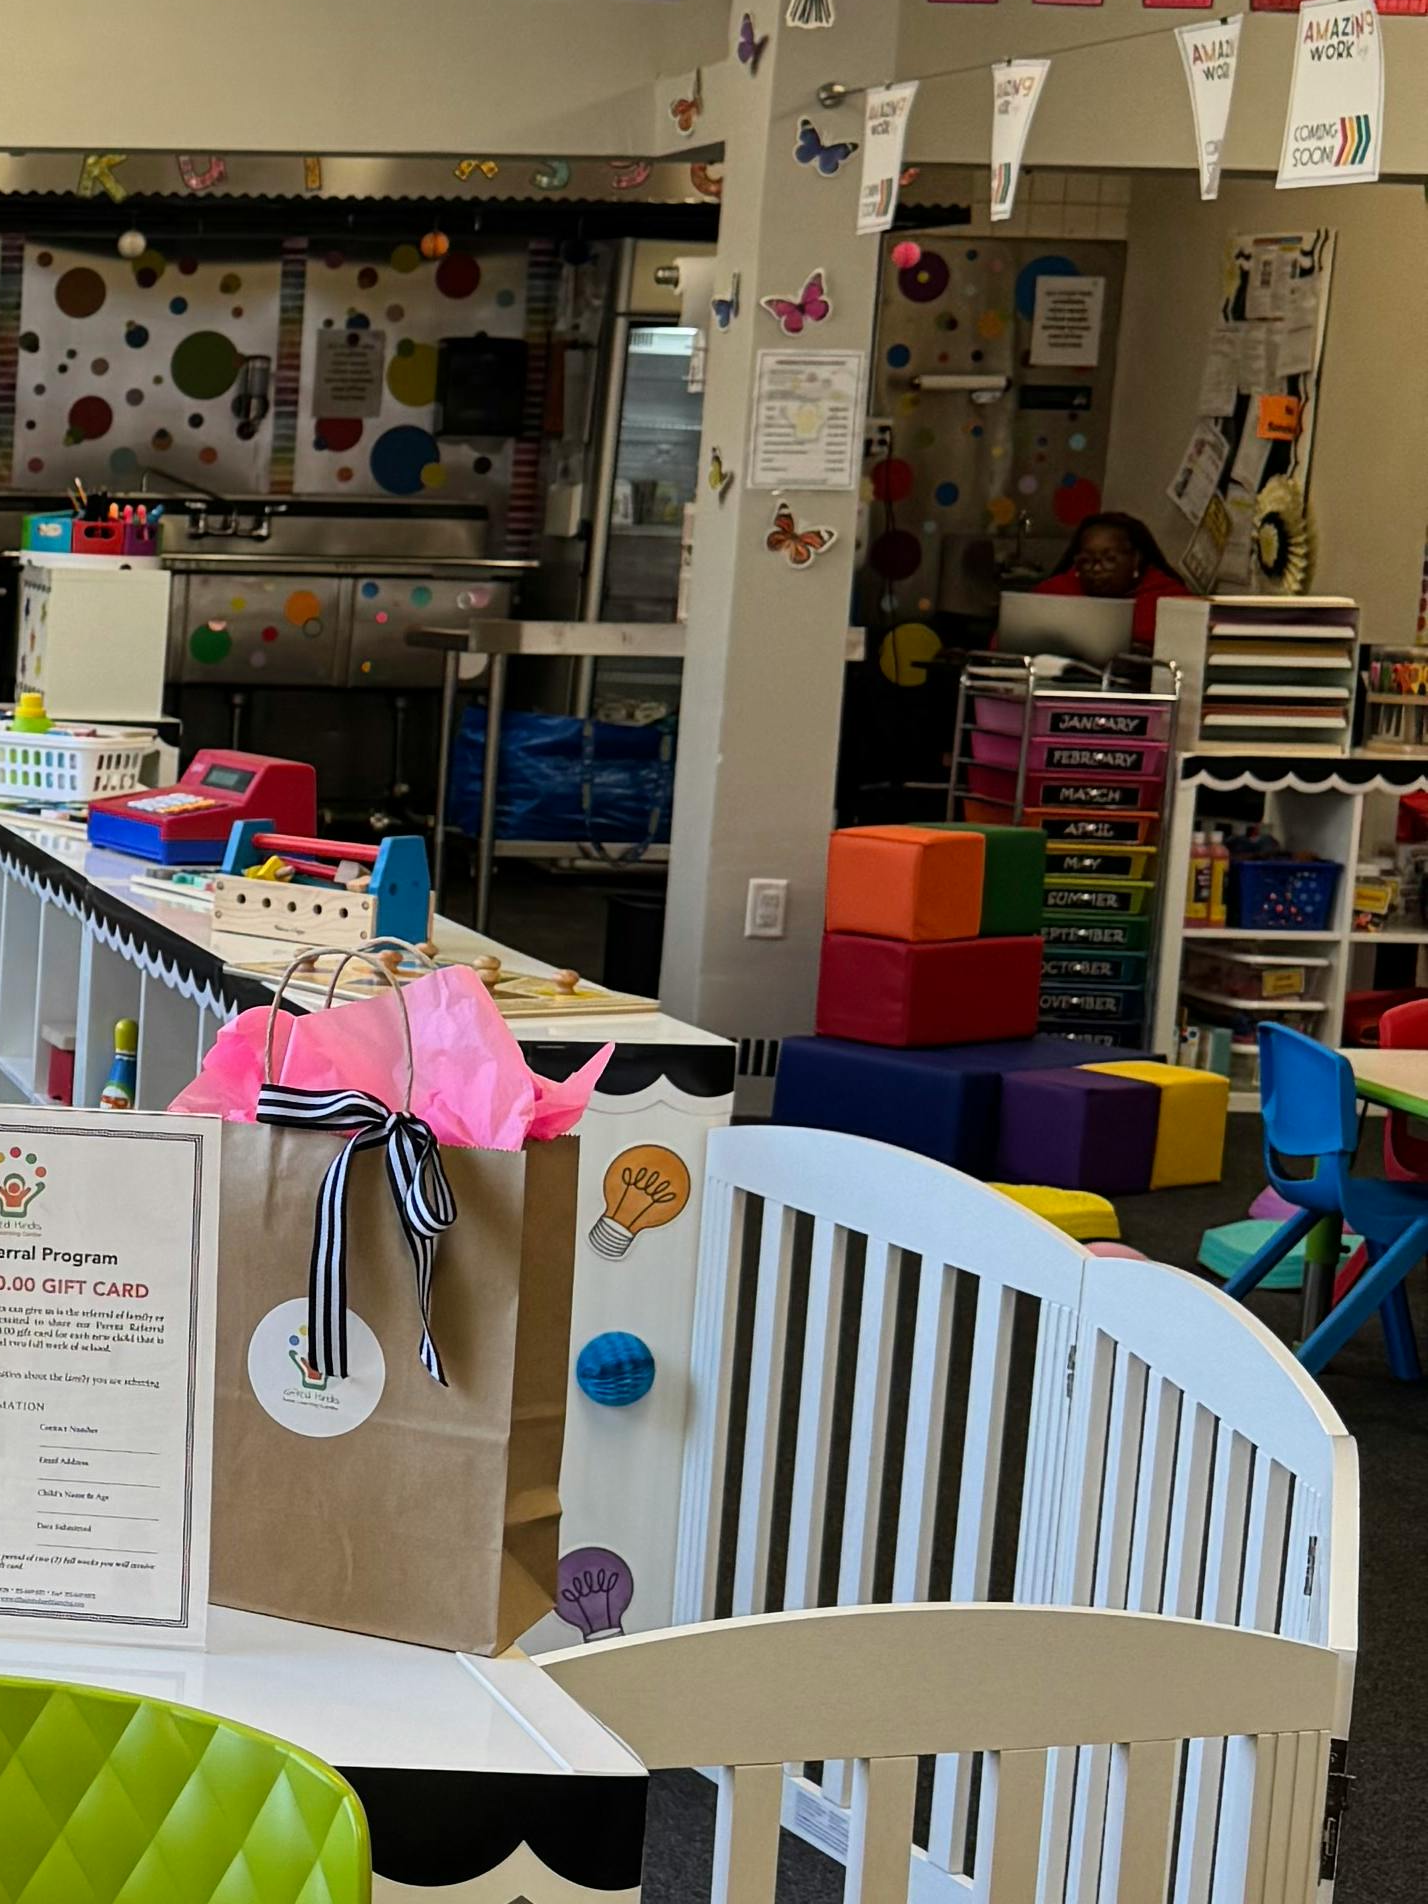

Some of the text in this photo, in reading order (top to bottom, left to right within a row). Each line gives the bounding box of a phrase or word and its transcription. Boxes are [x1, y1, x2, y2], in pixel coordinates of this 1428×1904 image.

[1310, 40, 1354, 62] WORK
[1294, 122, 1338, 143] COMING
[42, 1247, 118, 1267] Program
[42, 1279, 87, 1295] GIFT
[92, 1281, 149, 1299] CARD
